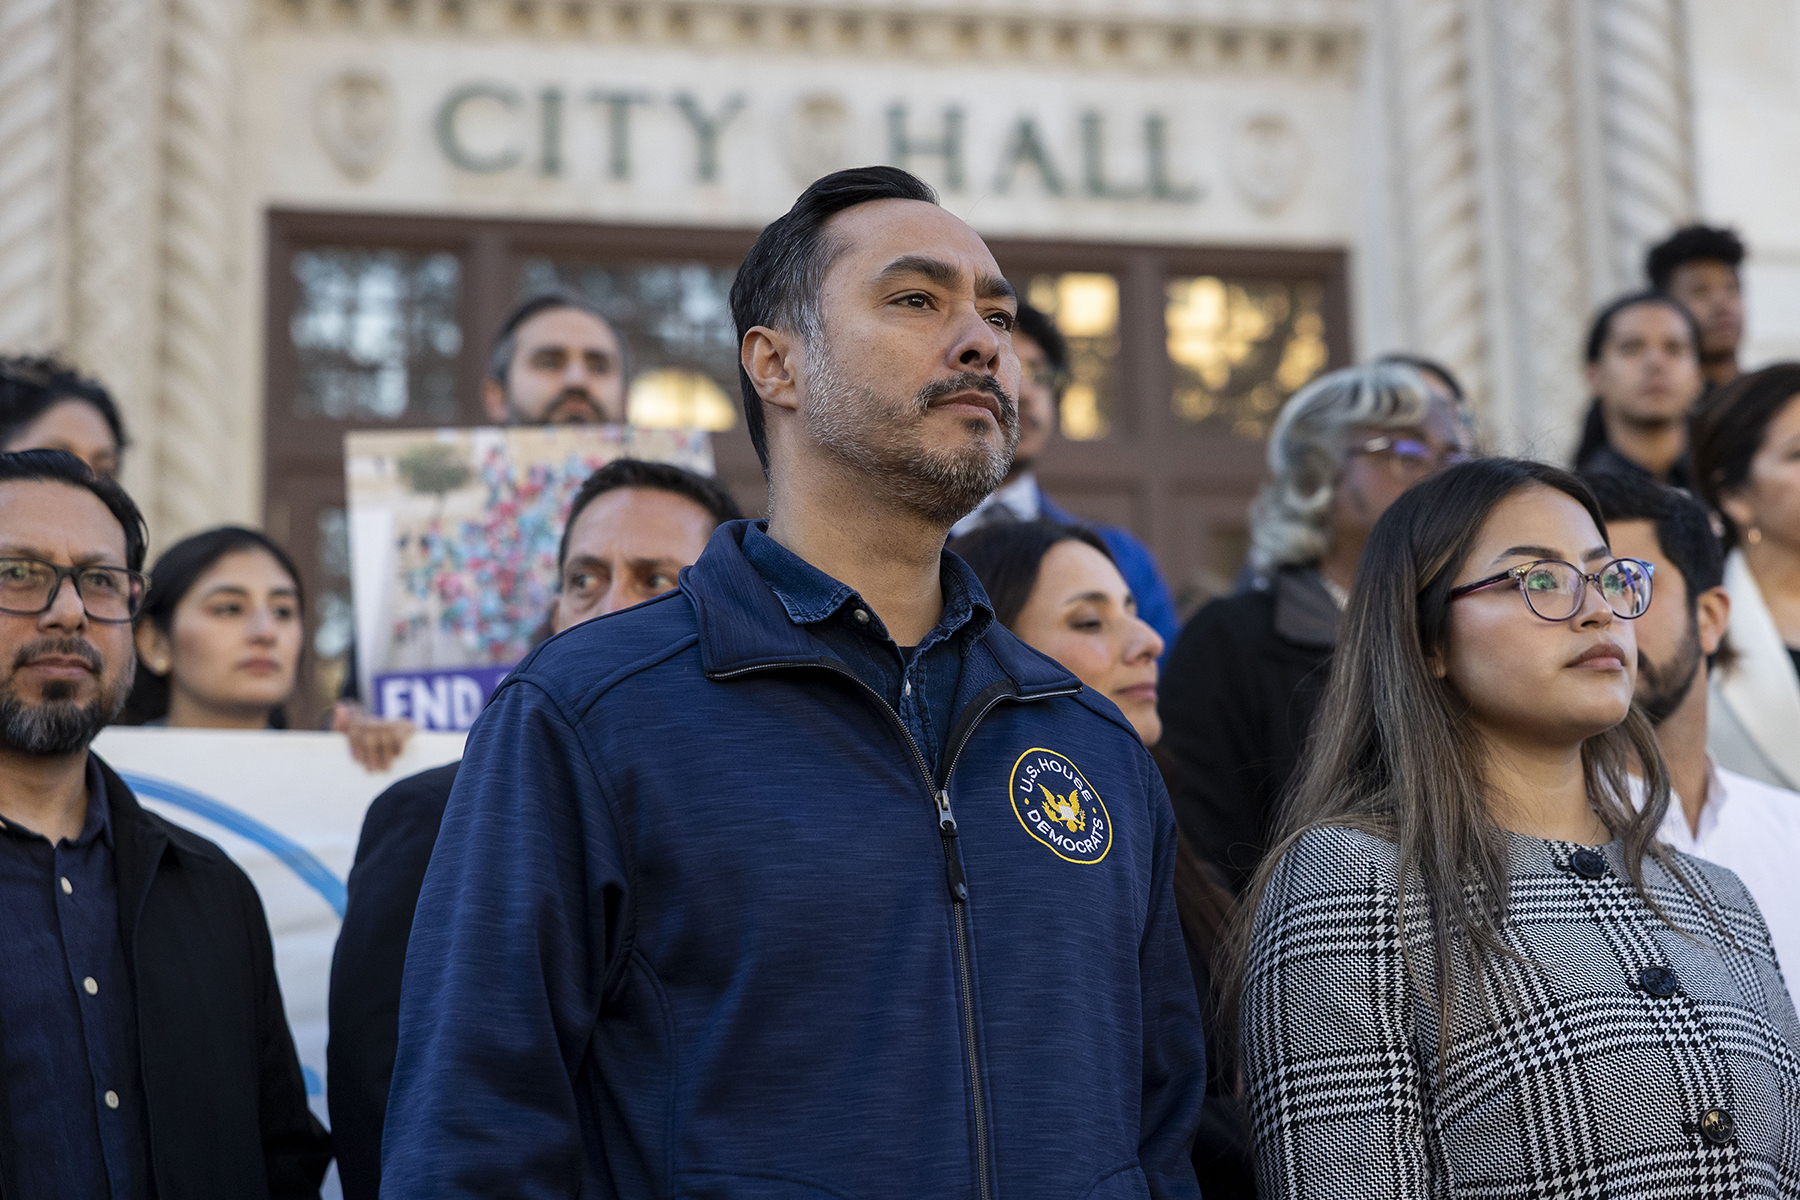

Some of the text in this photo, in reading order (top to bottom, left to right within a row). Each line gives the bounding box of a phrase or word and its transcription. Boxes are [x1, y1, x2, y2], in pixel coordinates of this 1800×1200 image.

[432, 83, 1203, 201] CITY HALL
[382, 674, 483, 729] END
[1038, 758, 1093, 801] HOUSE
[1026, 809, 1104, 853] DEMOCRATS
